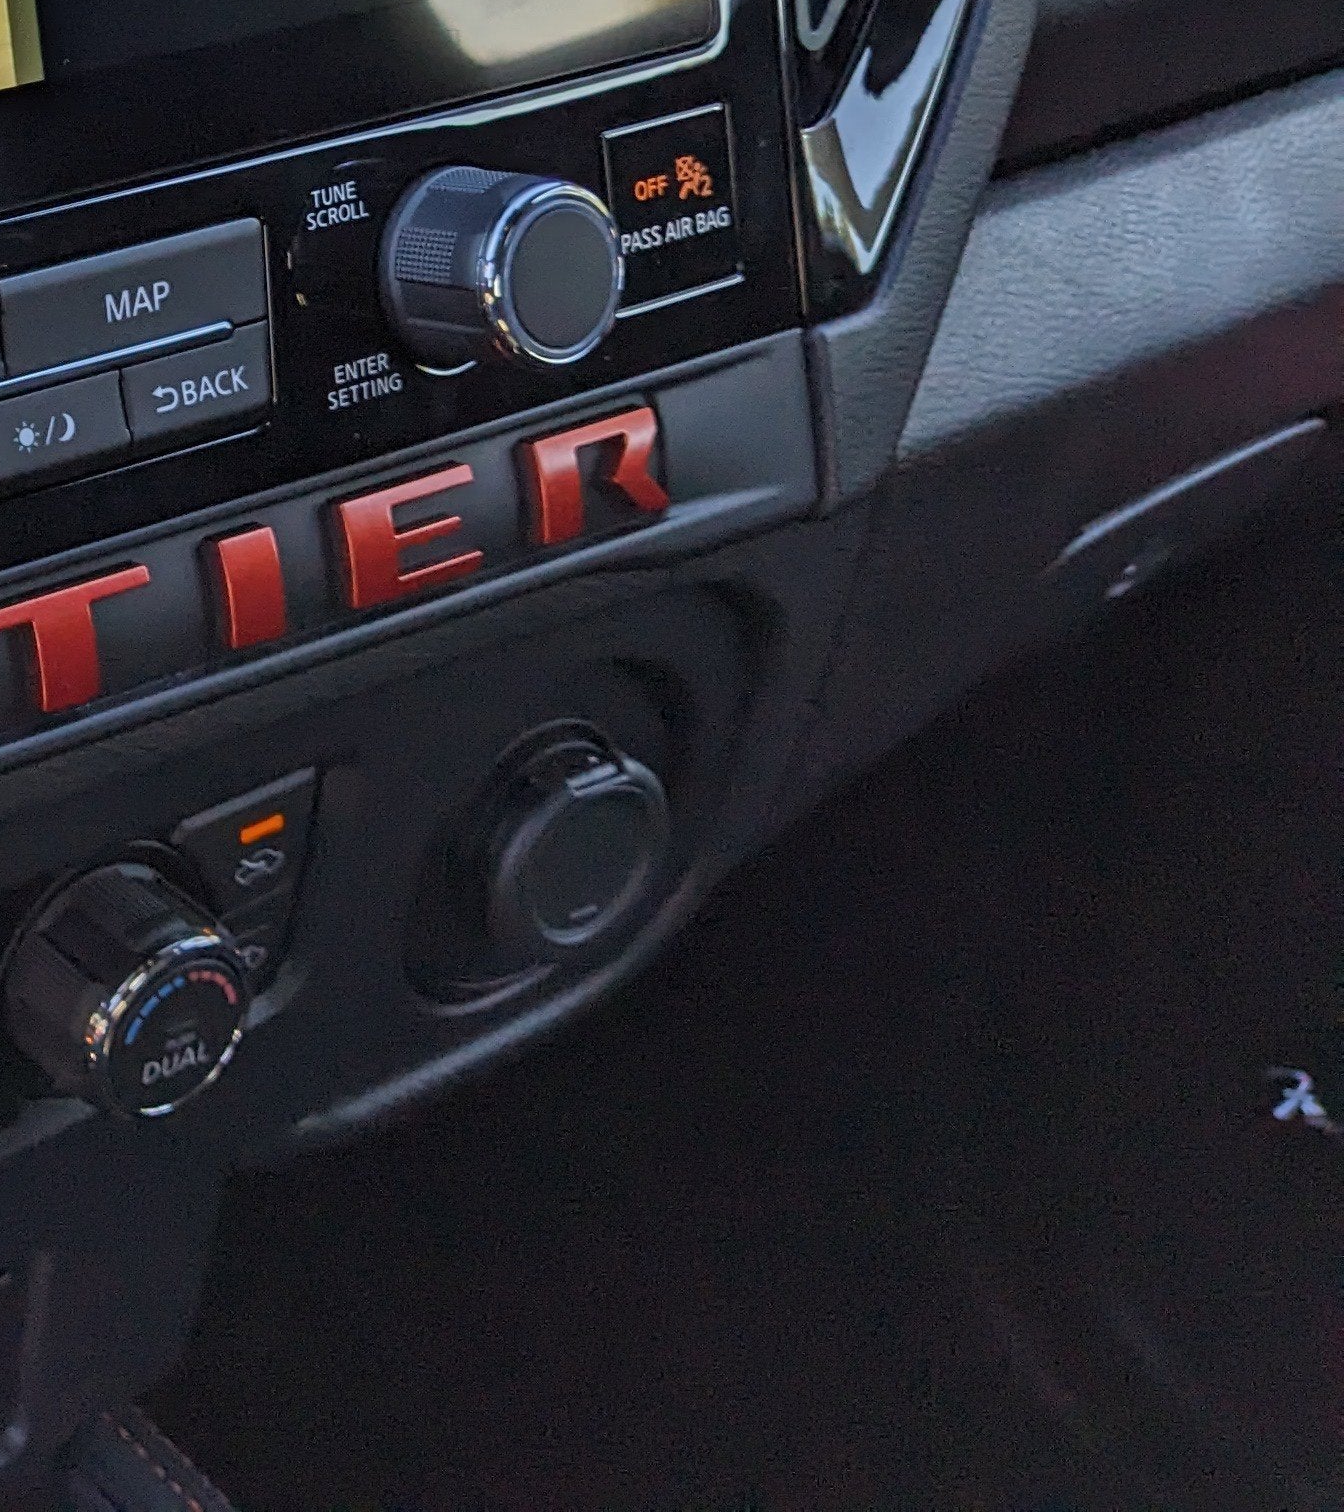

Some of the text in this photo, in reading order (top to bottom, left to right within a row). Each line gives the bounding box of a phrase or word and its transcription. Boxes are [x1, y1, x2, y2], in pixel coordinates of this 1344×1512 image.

[310, 180, 358, 207] TUNE
[634, 174, 669, 201] OFF
[306, 199, 369, 231] SCROLL
[621, 206, 732, 255] PASS AIR BAG
[105, 280, 170, 324] MAP
[181, 365, 249, 408] BACK
[333, 352, 391, 385] ENTER
[327, 373, 403, 411] SETTING
[142, 1039, 209, 1086] DUAL
